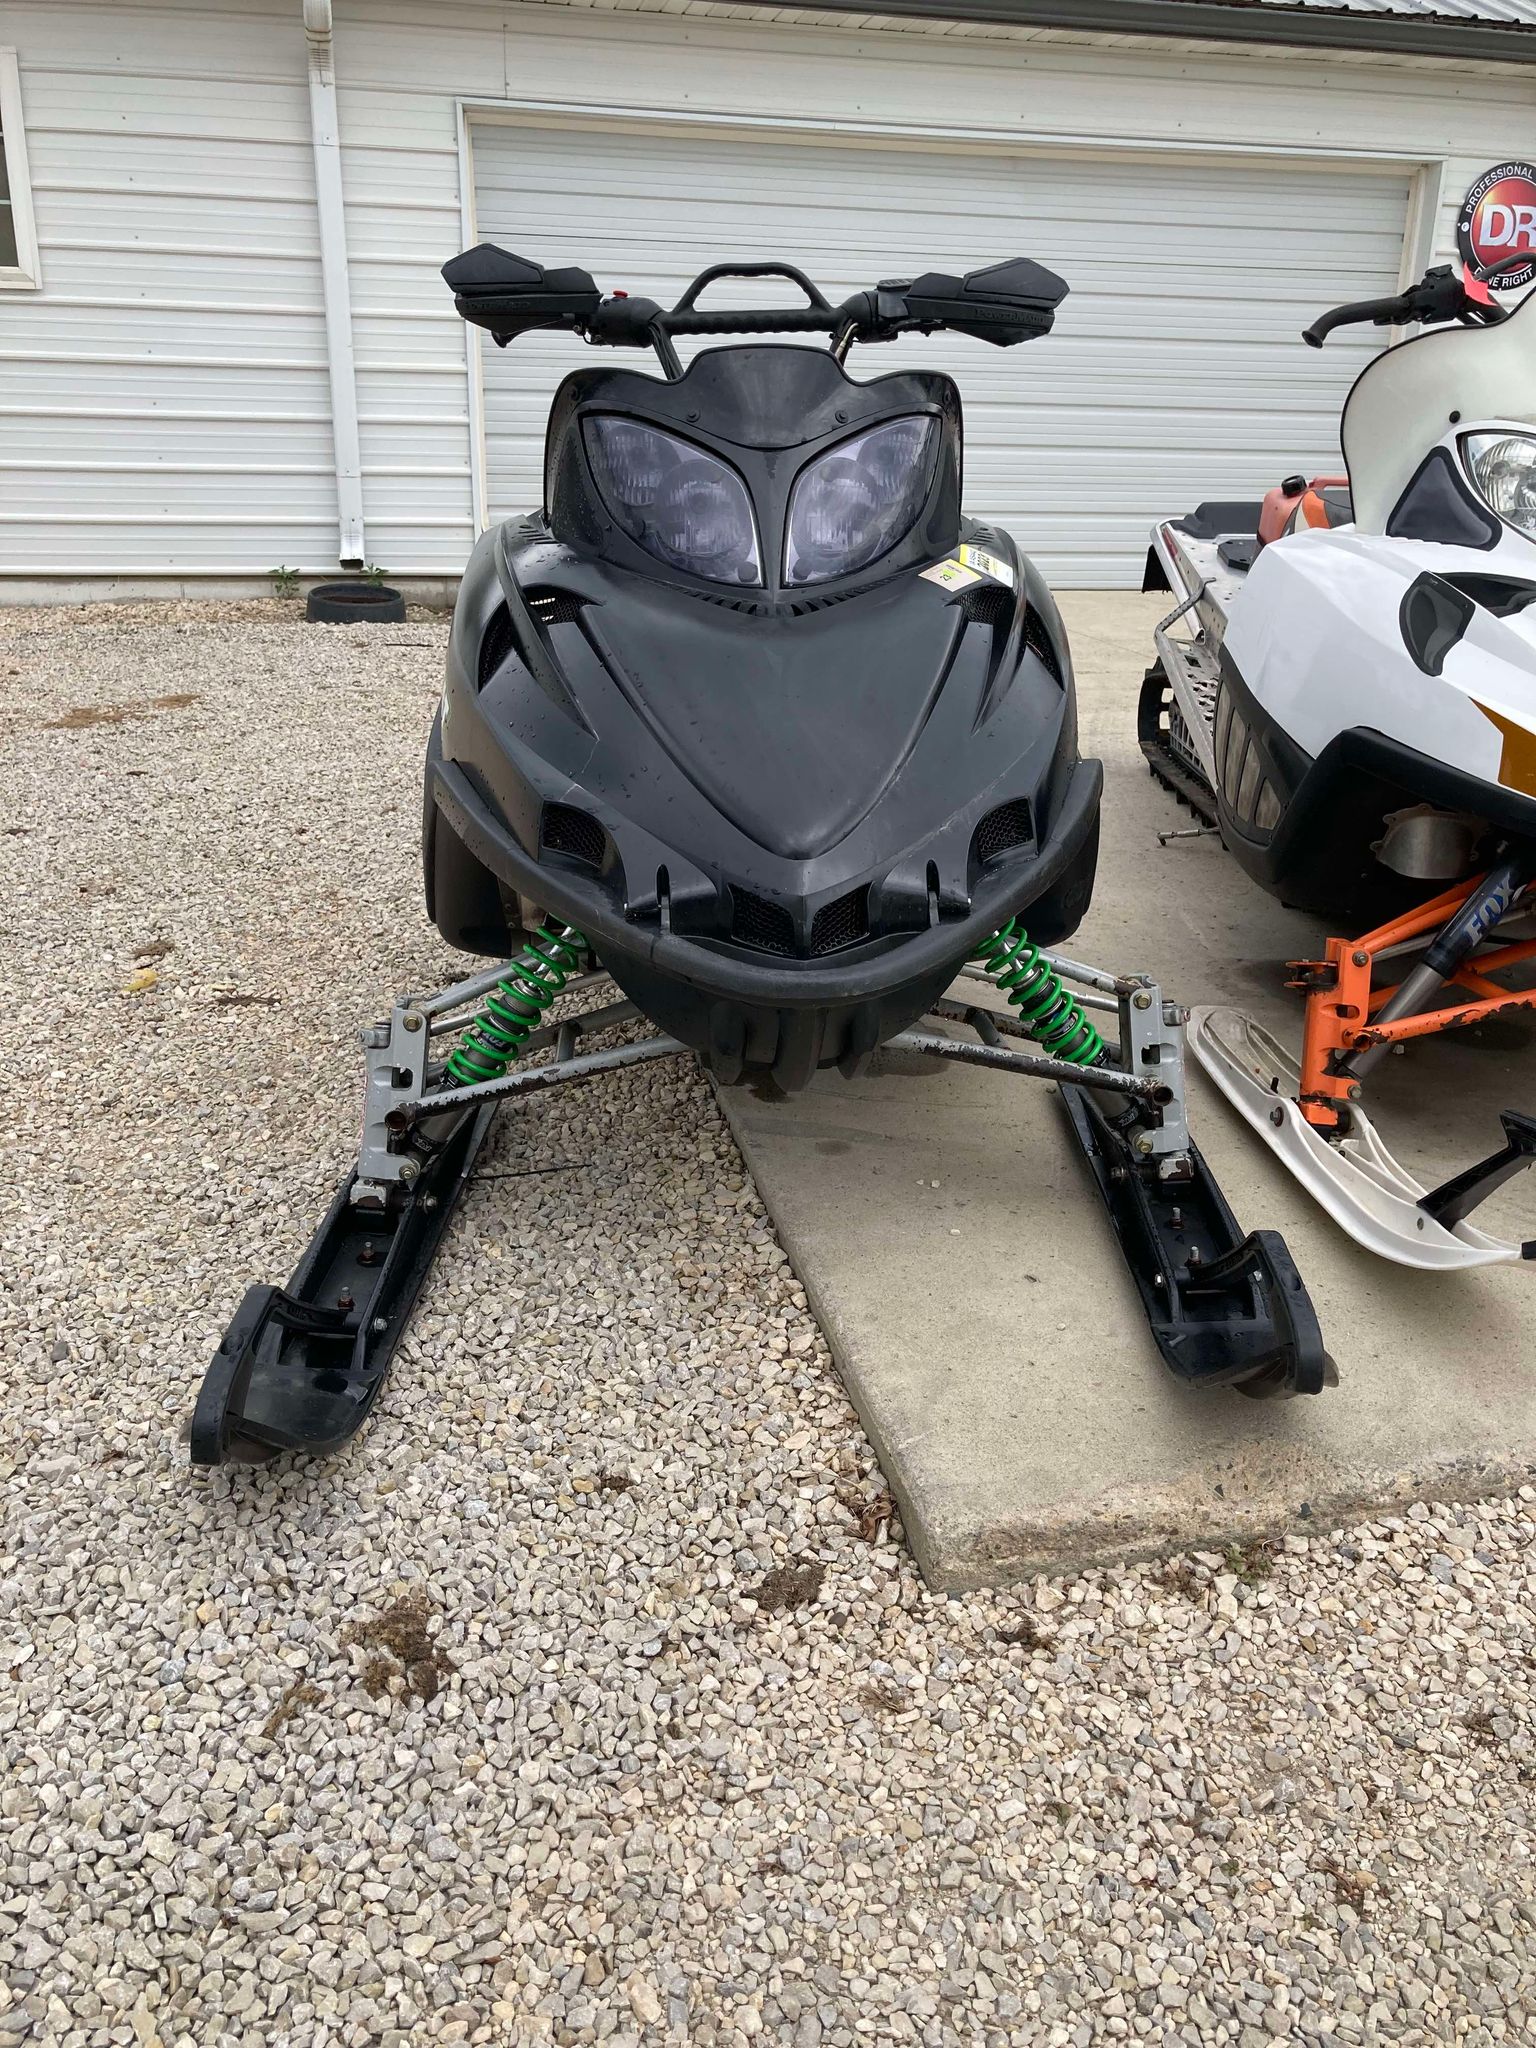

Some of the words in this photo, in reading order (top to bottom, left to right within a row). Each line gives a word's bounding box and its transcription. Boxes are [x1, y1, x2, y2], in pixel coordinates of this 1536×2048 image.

[1465, 165, 1533, 214] PROFESSIONAL
[1479, 204, 1536, 248] DR
[1501, 267, 1533, 287] RIGHT
[1463, 871, 1515, 947] FOX
